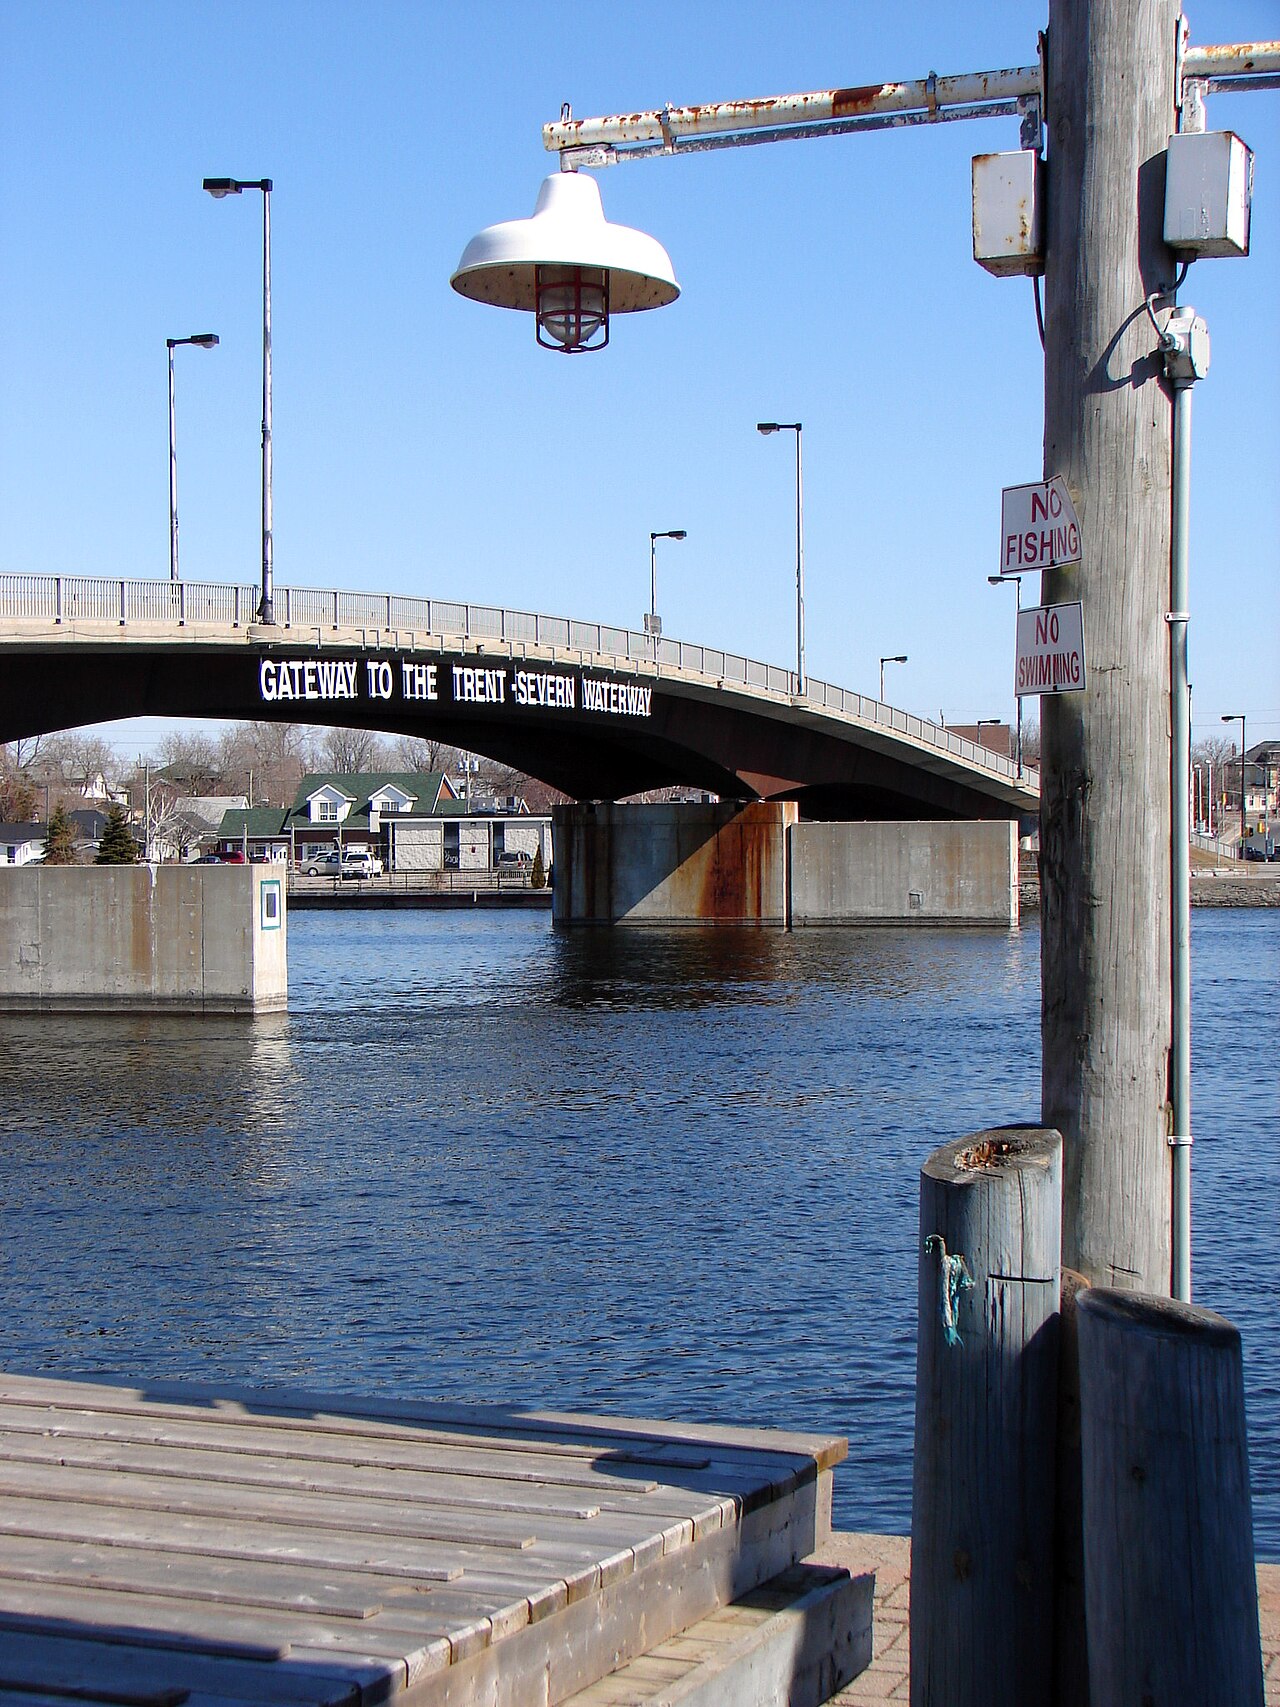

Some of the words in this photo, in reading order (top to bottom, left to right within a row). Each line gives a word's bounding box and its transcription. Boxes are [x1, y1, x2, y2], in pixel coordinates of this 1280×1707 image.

[1031, 489, 1062, 523] NO
[1006, 523, 1078, 566] FISHING
[1035, 614, 1059, 646] NO
[1018, 651, 1080, 688] SWIMMING
[260, 660, 358, 701] GATEWAY
[367, 661, 394, 699] TO
[403, 664, 438, 700] THE
[453, 666, 507, 704] TRENT
[583, 678, 653, 717] WATERWAY
